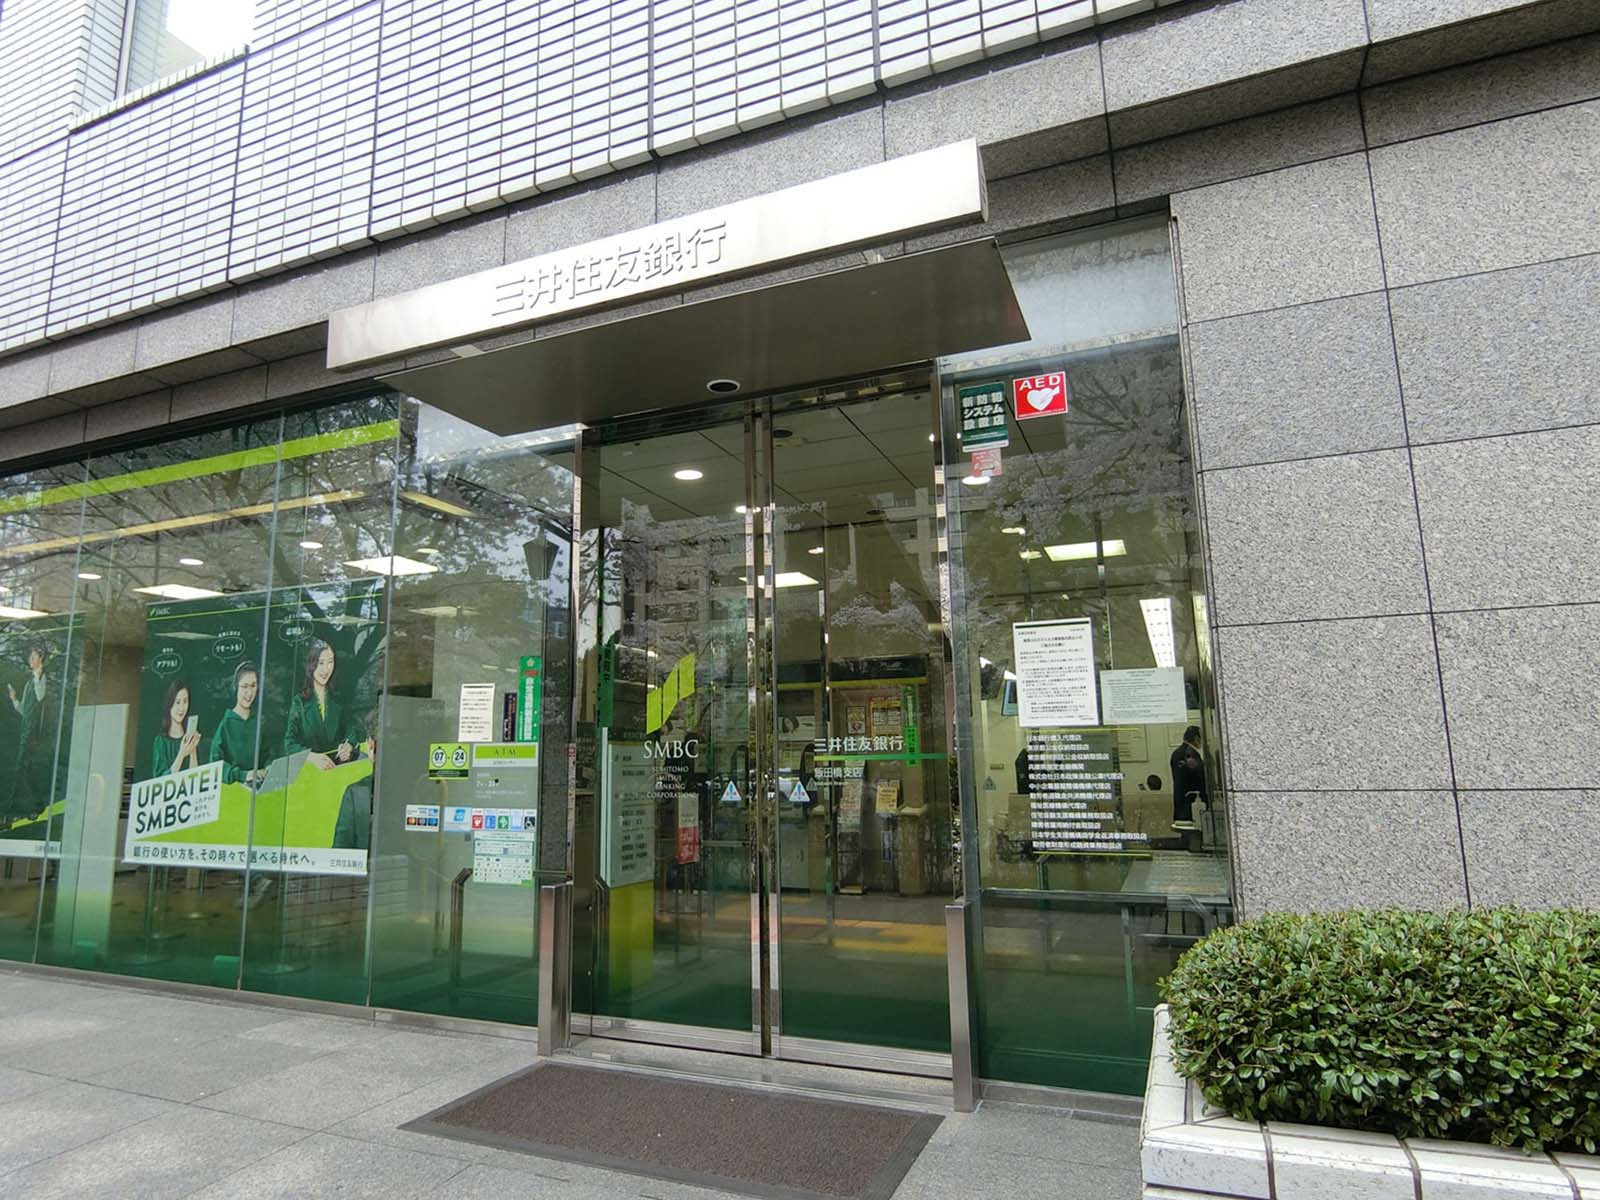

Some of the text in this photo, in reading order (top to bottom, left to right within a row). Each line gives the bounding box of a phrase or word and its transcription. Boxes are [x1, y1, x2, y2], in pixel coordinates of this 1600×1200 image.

[491, 220, 727, 316] 三井住友銀行
[1019, 375, 1061, 391] AED
[963, 405, 1004, 419] システム
[643, 739, 699, 759] SMBC
[814, 735, 905, 752] 三井住友銀行
[434, 751, 465, 761] 07 24
[814, 767, 864, 778] 飯田橋支店
[138, 767, 219, 808] UPDATE!
[135, 801, 192, 834] SMBC
